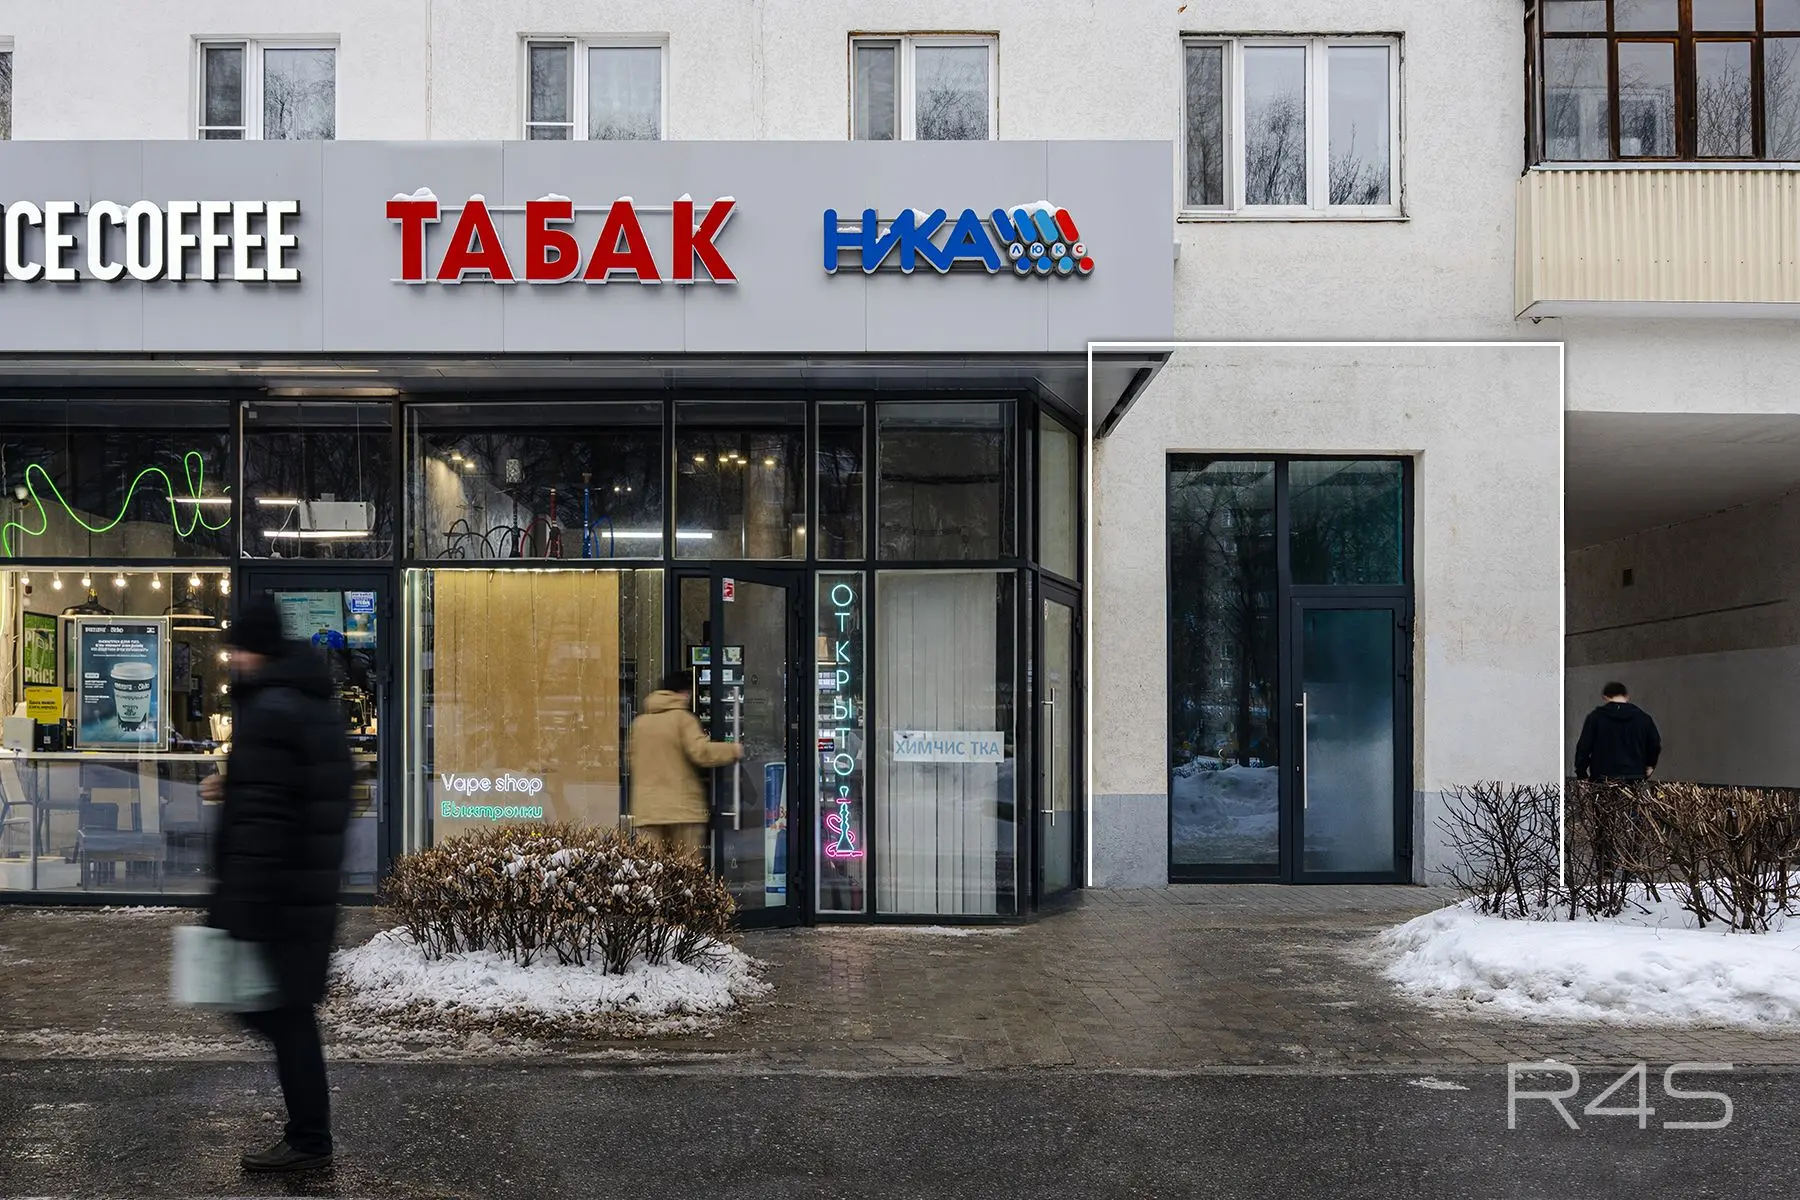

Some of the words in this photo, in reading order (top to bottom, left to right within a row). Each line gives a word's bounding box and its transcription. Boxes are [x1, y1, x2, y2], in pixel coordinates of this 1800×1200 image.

[87, 200, 300, 281] COFFEE
[386, 200, 739, 284] ТАБАК
[824, 208, 1002, 274] НИКА
[1011, 244, 1083, 255] ЛЮКС
[25, 666, 55, 684] PRICE
[831, 584, 854, 776] ОТКРЫТО
[896, 740, 966, 756] ХИМЧИС
[970, 740, 1000, 756] ТКА
[441, 773, 491, 796] Vape
[495, 773, 543, 796] shop
